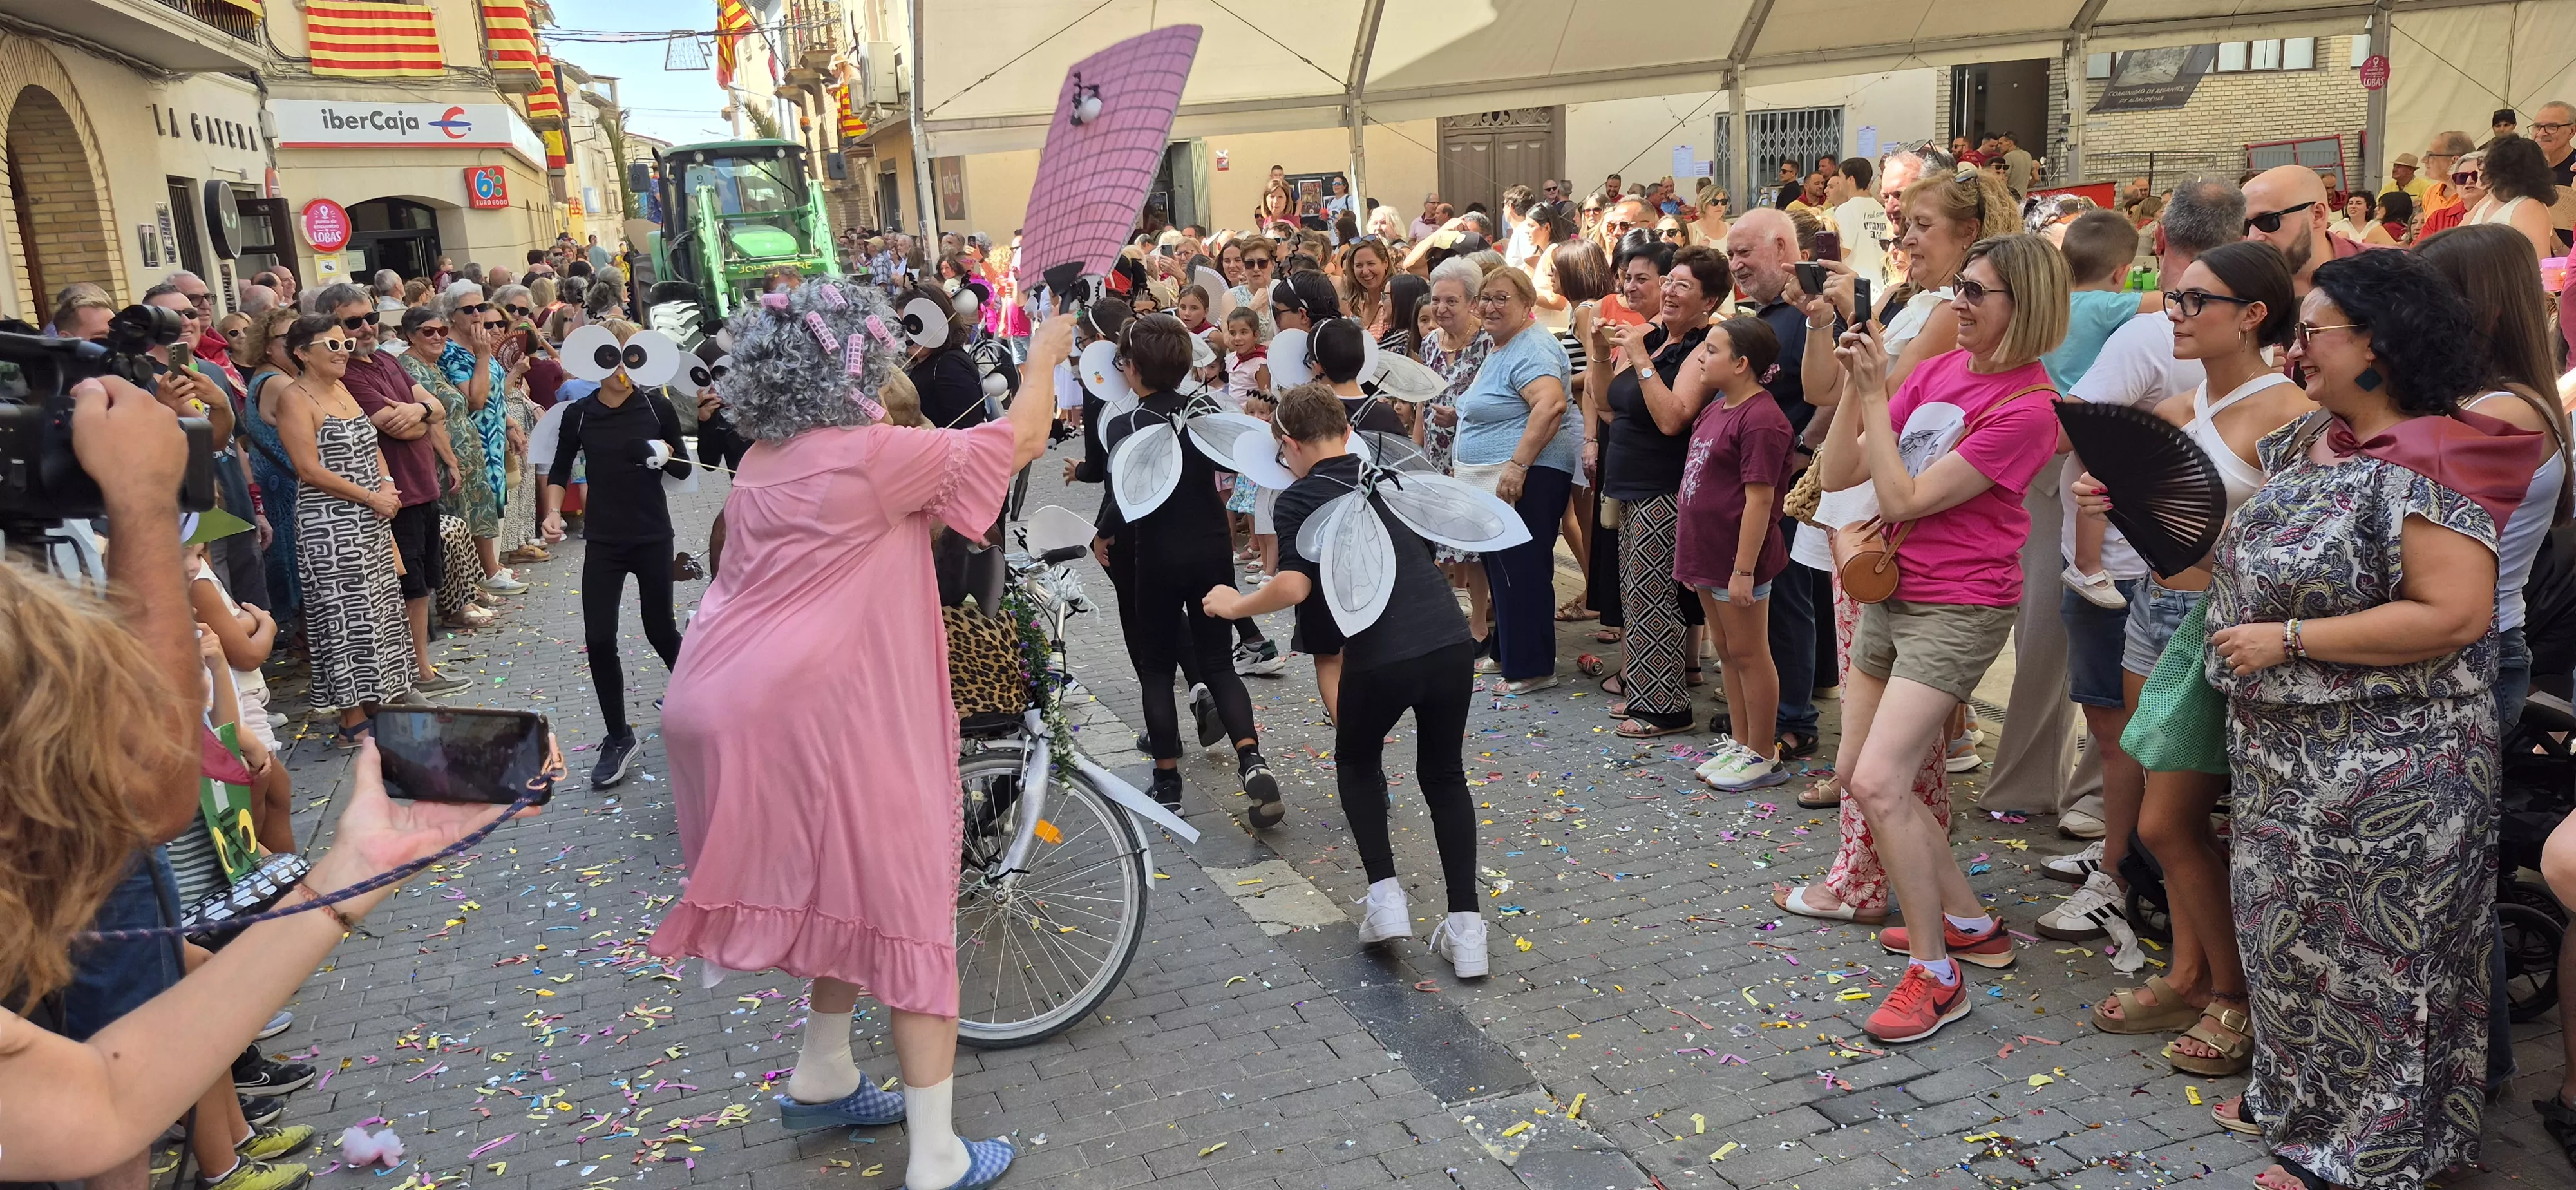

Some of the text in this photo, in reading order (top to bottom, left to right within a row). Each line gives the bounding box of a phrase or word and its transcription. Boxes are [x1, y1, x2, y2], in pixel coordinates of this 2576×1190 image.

[2363, 77, 2385, 87] LOBAS
[2108, 88, 2145, 97] COMUNIDAD
[321, 108, 420, 135] iberCaja
[152, 103, 258, 152] LA GATERA
[697, 175, 703, 184] 9
[313, 232, 341, 243] LOBAS
